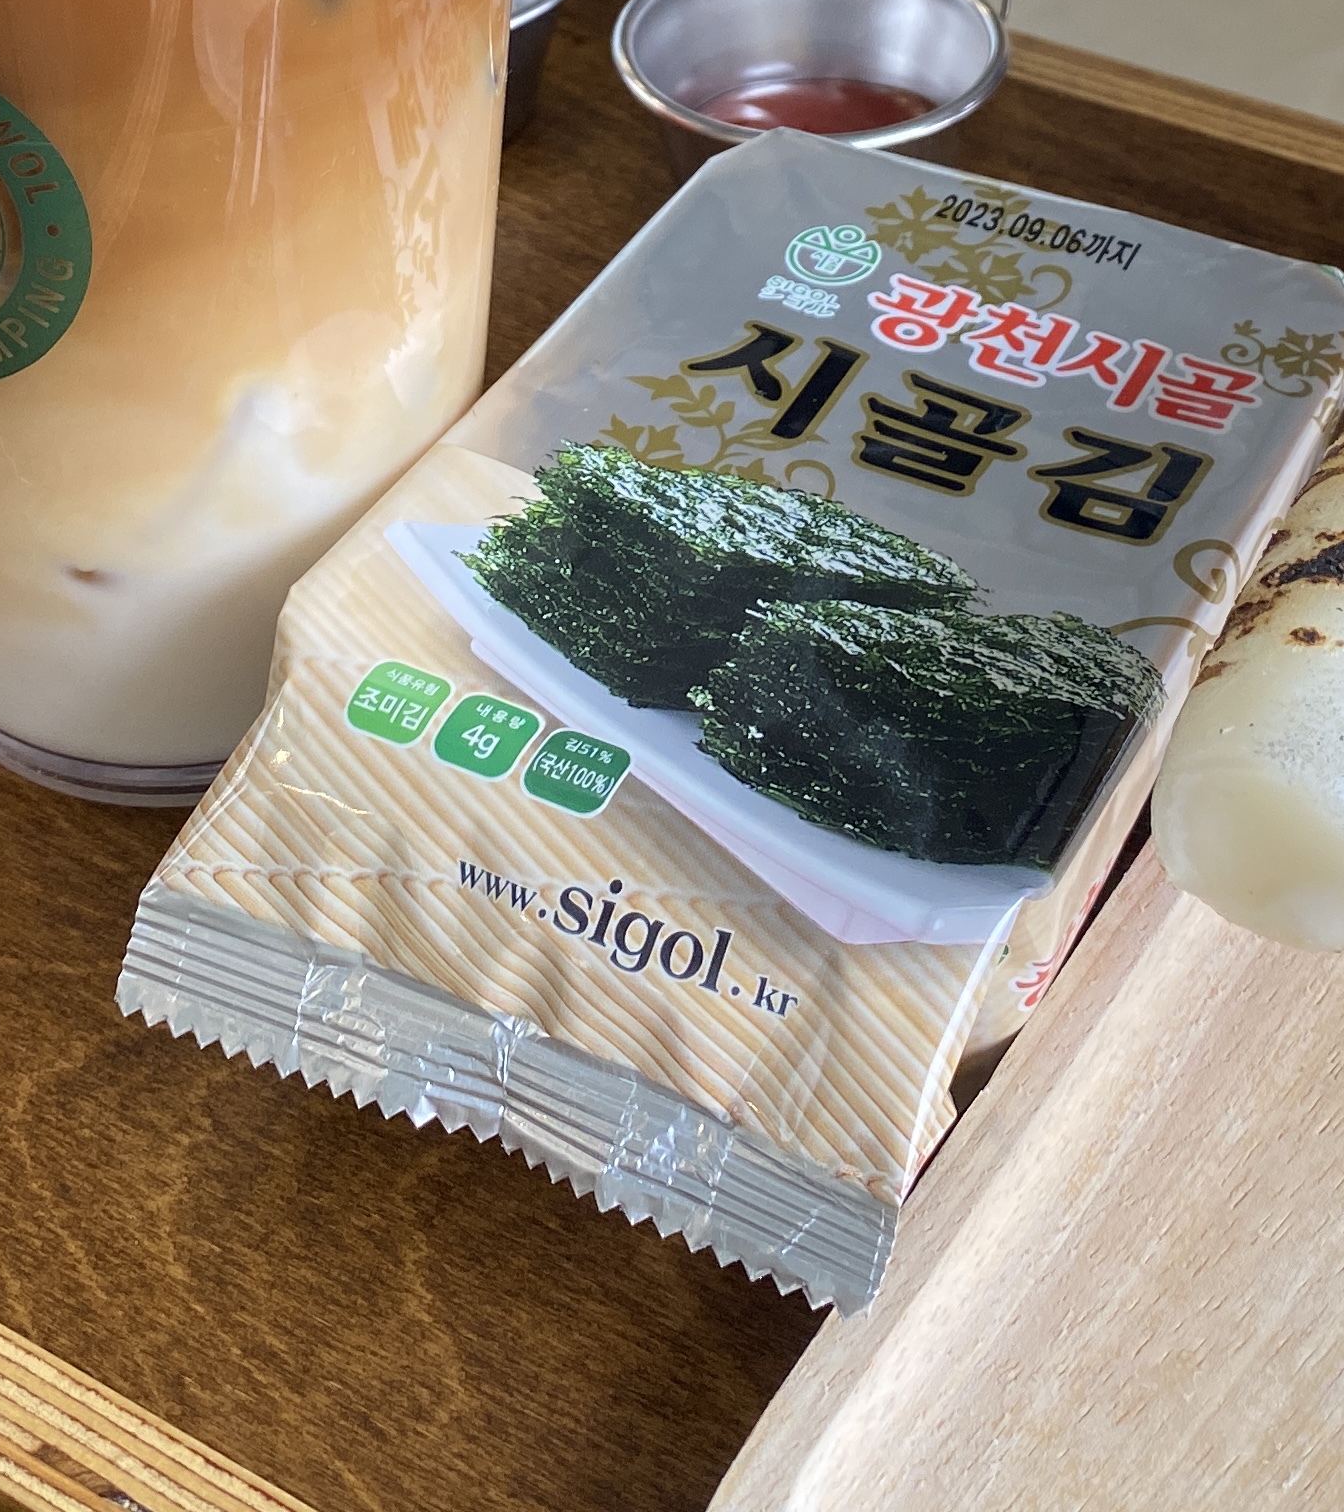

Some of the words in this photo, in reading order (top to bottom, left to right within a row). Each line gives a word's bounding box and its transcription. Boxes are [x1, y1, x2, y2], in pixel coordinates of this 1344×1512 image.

[934, 194, 1143, 271] 2023.09.06까지
[870, 275, 1260, 432] 광천시골
[684, 323, 1211, 544] 시골김
[385, 668, 441, 697] 식품유형
[353, 686, 431, 732] 조미김
[461, 723, 501, 760] 4g
[531, 749, 616, 798] (국산100%)
